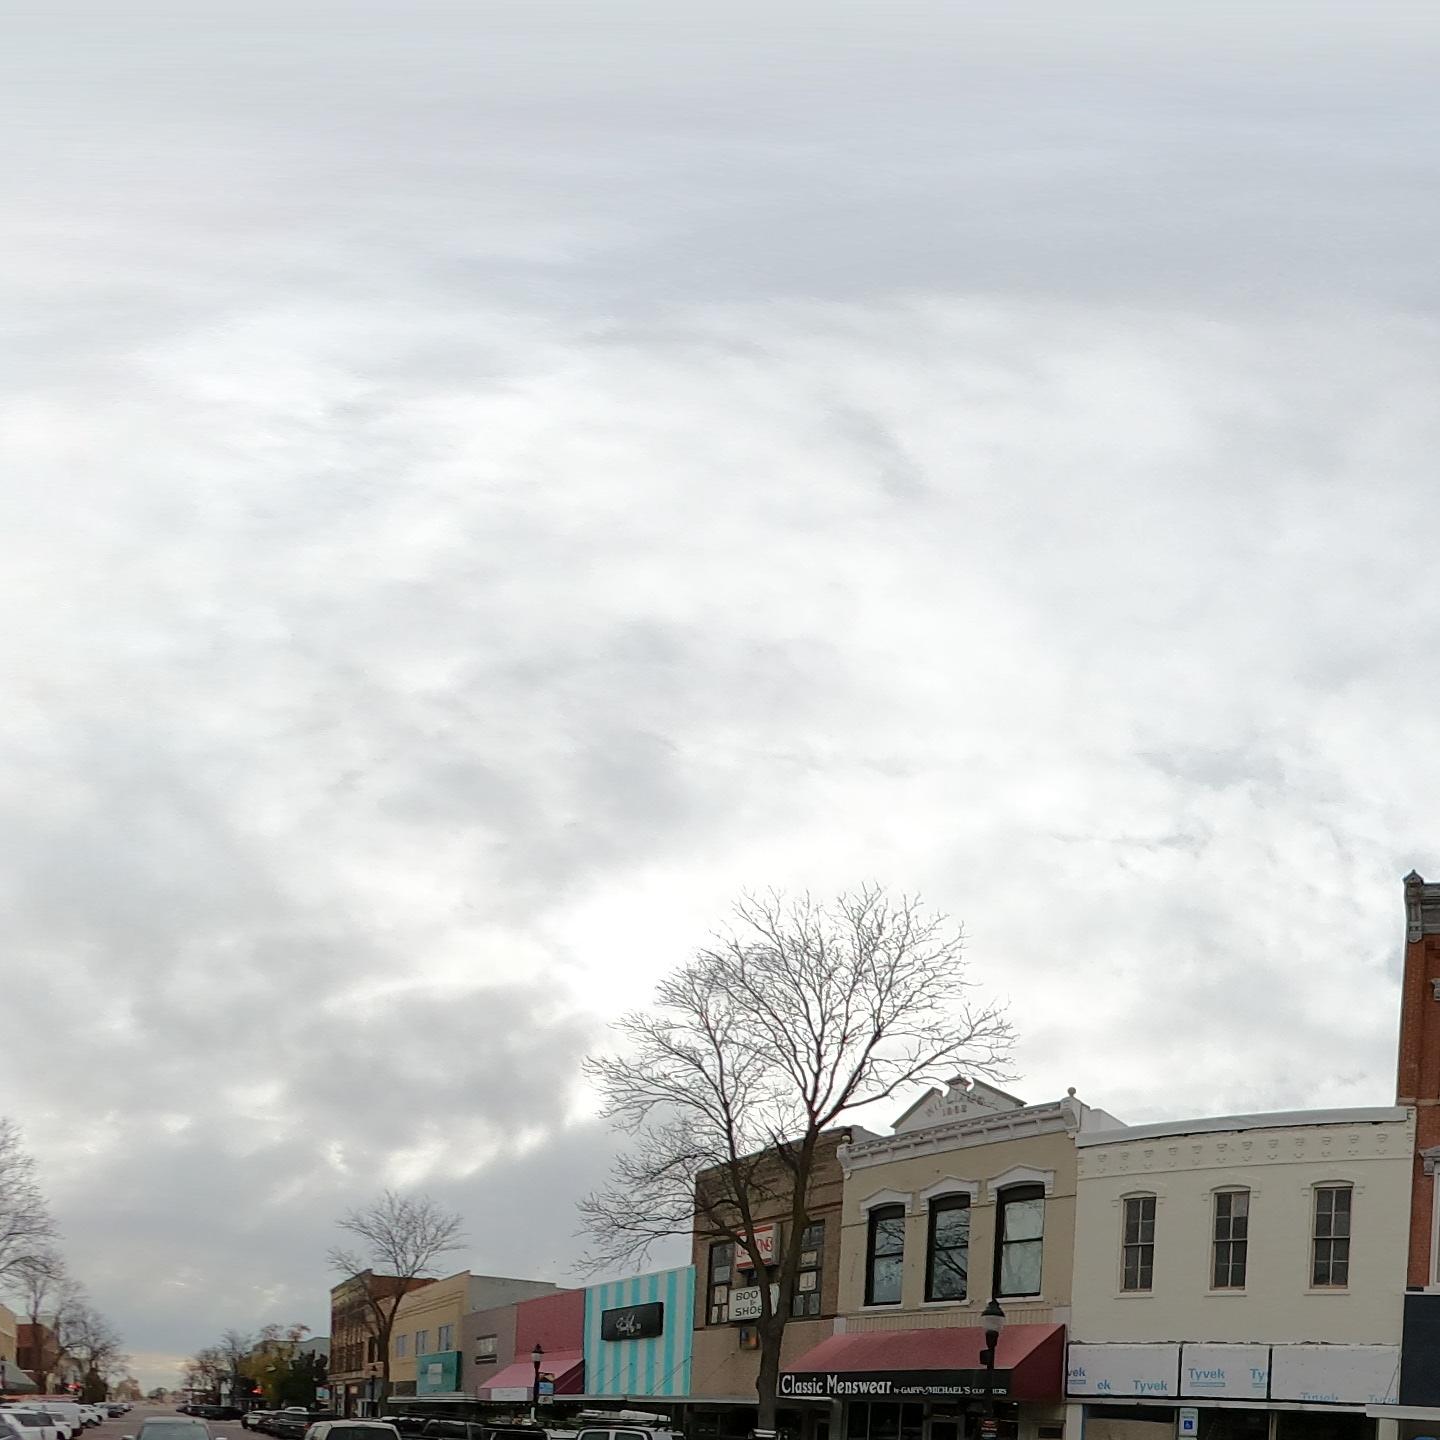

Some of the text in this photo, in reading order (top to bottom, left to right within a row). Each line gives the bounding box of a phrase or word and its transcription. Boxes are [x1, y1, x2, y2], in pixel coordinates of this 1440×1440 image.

[1188, 1368, 1225, 1381] Tyvek
[781, 1374, 823, 1394] Classic
[826, 1374, 892, 1394] Menswear
[1133, 1380, 1168, 1392] Tyvek
